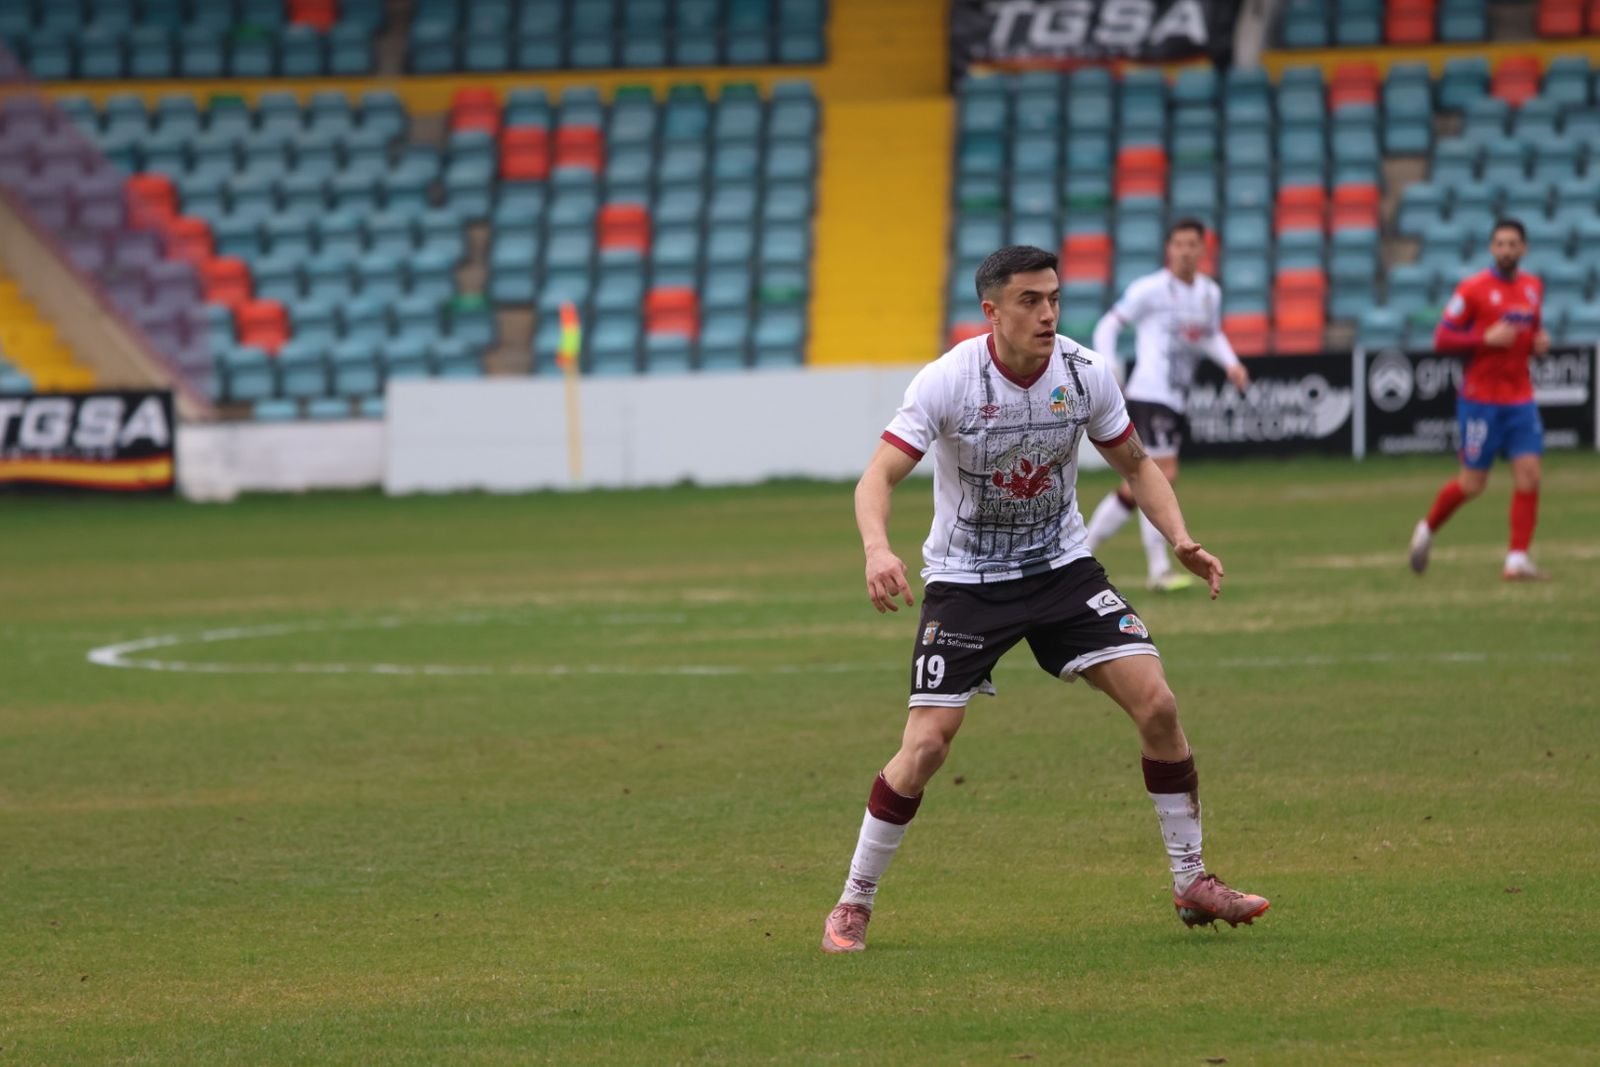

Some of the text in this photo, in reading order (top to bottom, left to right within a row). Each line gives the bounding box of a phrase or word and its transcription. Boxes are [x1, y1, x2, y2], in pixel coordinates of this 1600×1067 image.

[986, 0, 1208, 49] TGSA
[938, 629, 985, 642] Ayuntamiento
[946, 638, 984, 650] Salamanca
[915, 654, 946, 690] 19
